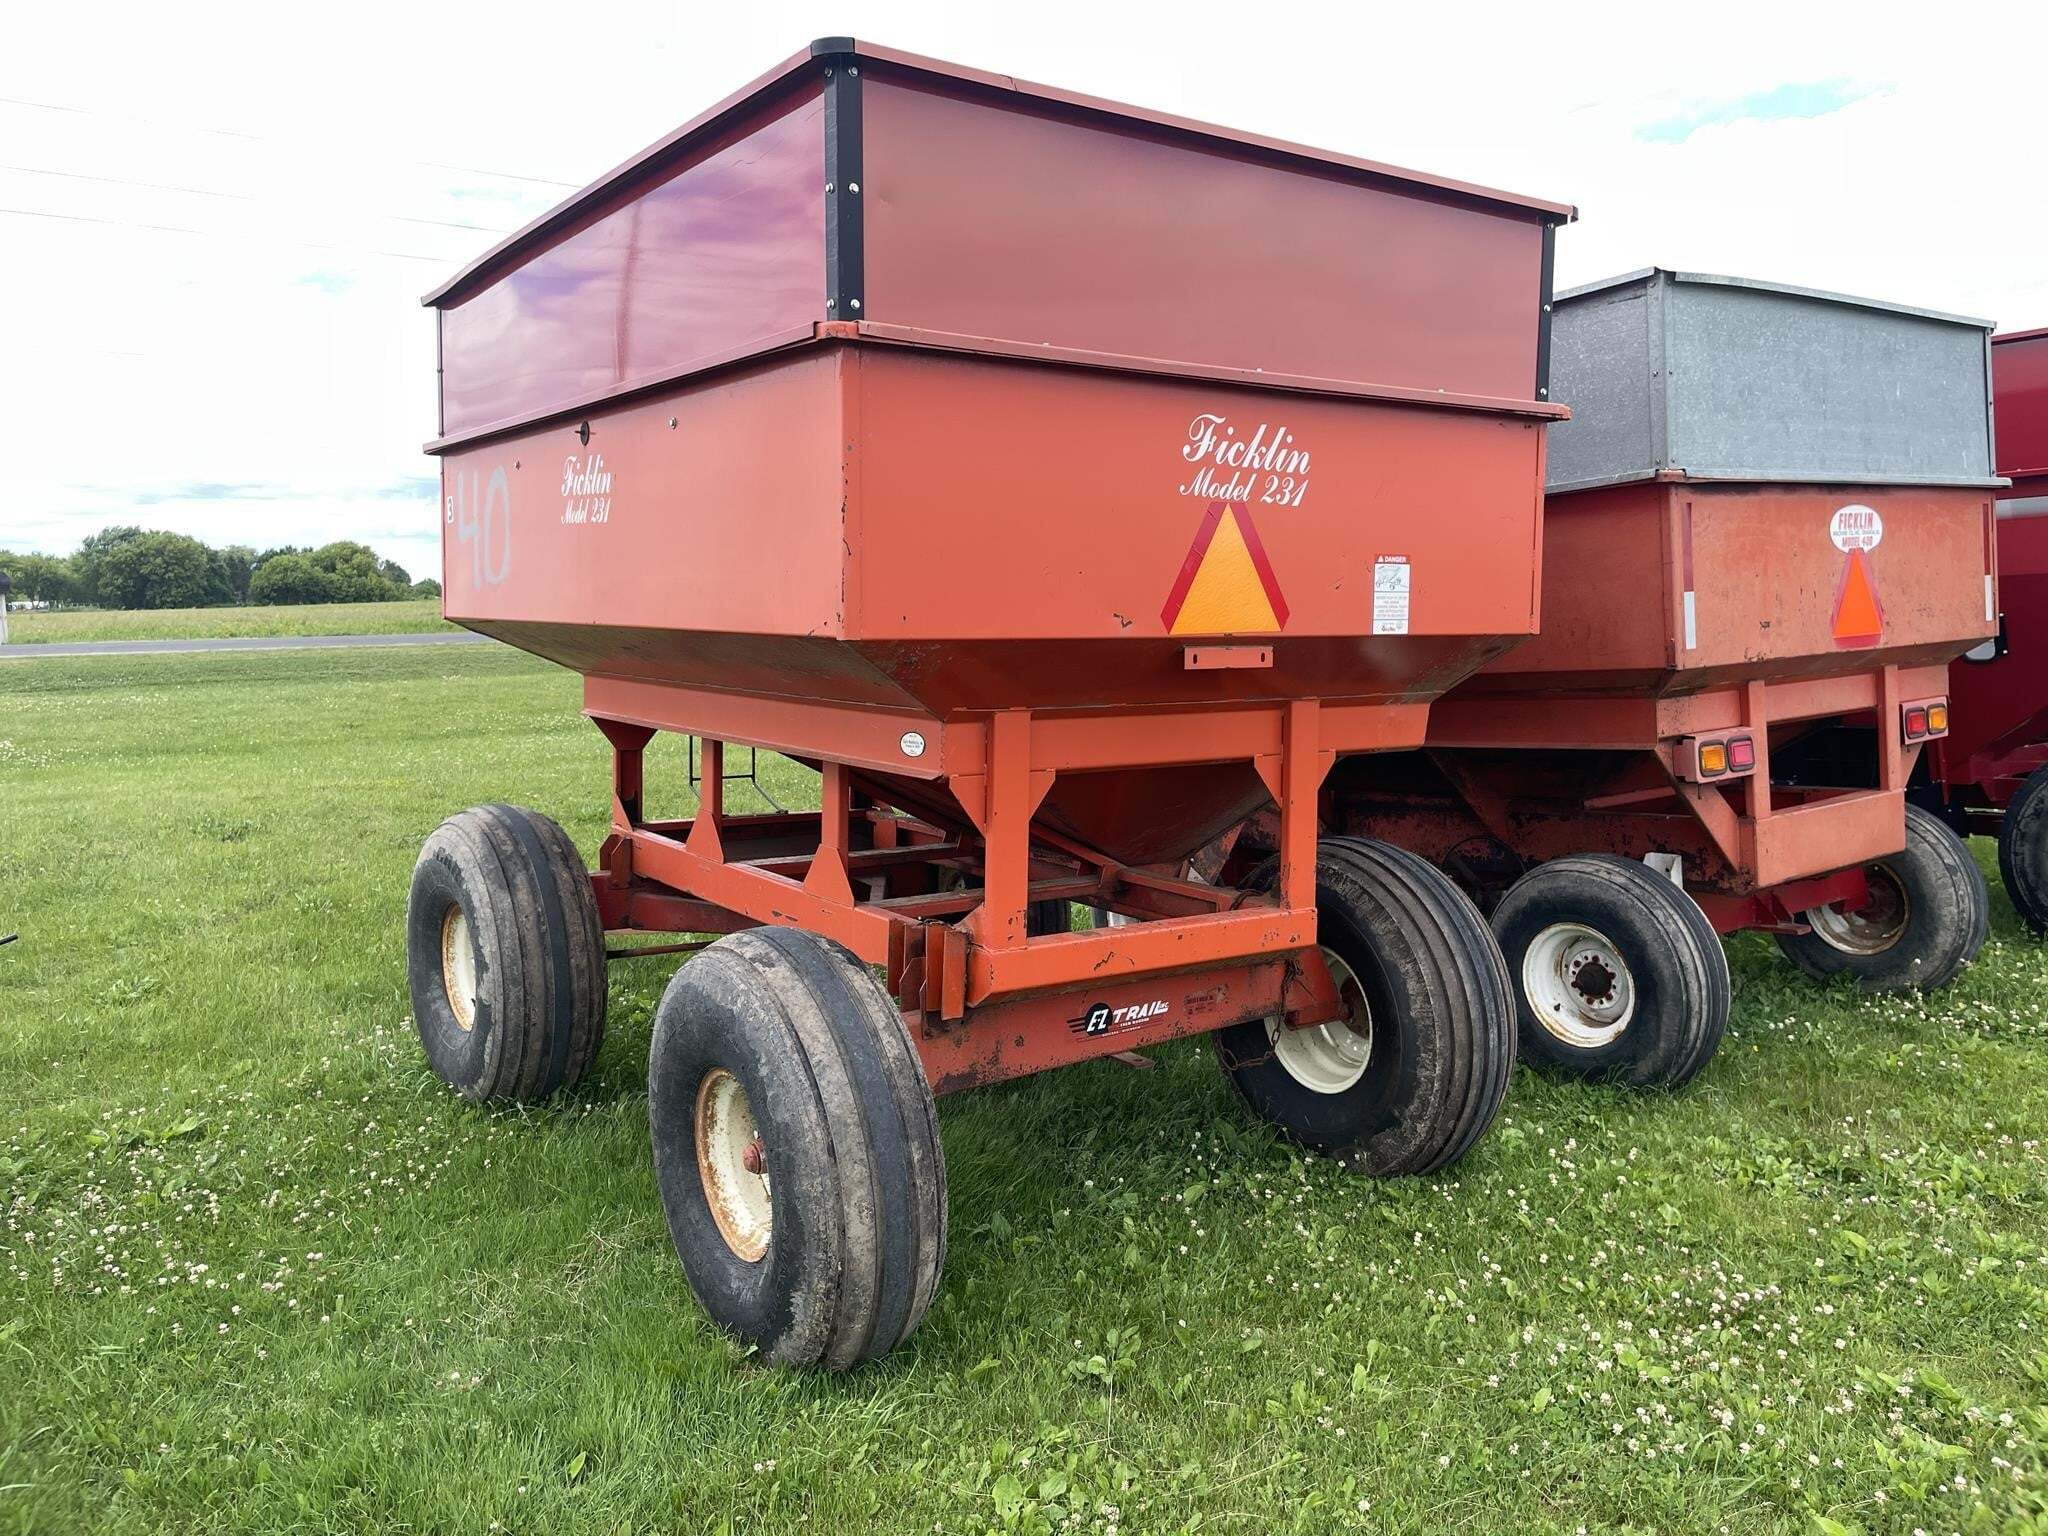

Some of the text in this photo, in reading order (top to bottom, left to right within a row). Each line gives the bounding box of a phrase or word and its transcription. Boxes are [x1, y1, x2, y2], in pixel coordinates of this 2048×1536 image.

[1182, 413, 1311, 475] Ficklin
[561, 454, 611, 497] Ficklin
[1179, 466, 1310, 507] Model 231
[456, 464, 512, 590] 40
[560, 497, 611, 525] Model 231
[1838, 512, 1874, 531] FICKLIN
[1384, 555, 1407, 563] DANGER
[1113, 1000, 1169, 1024] TRAIL
